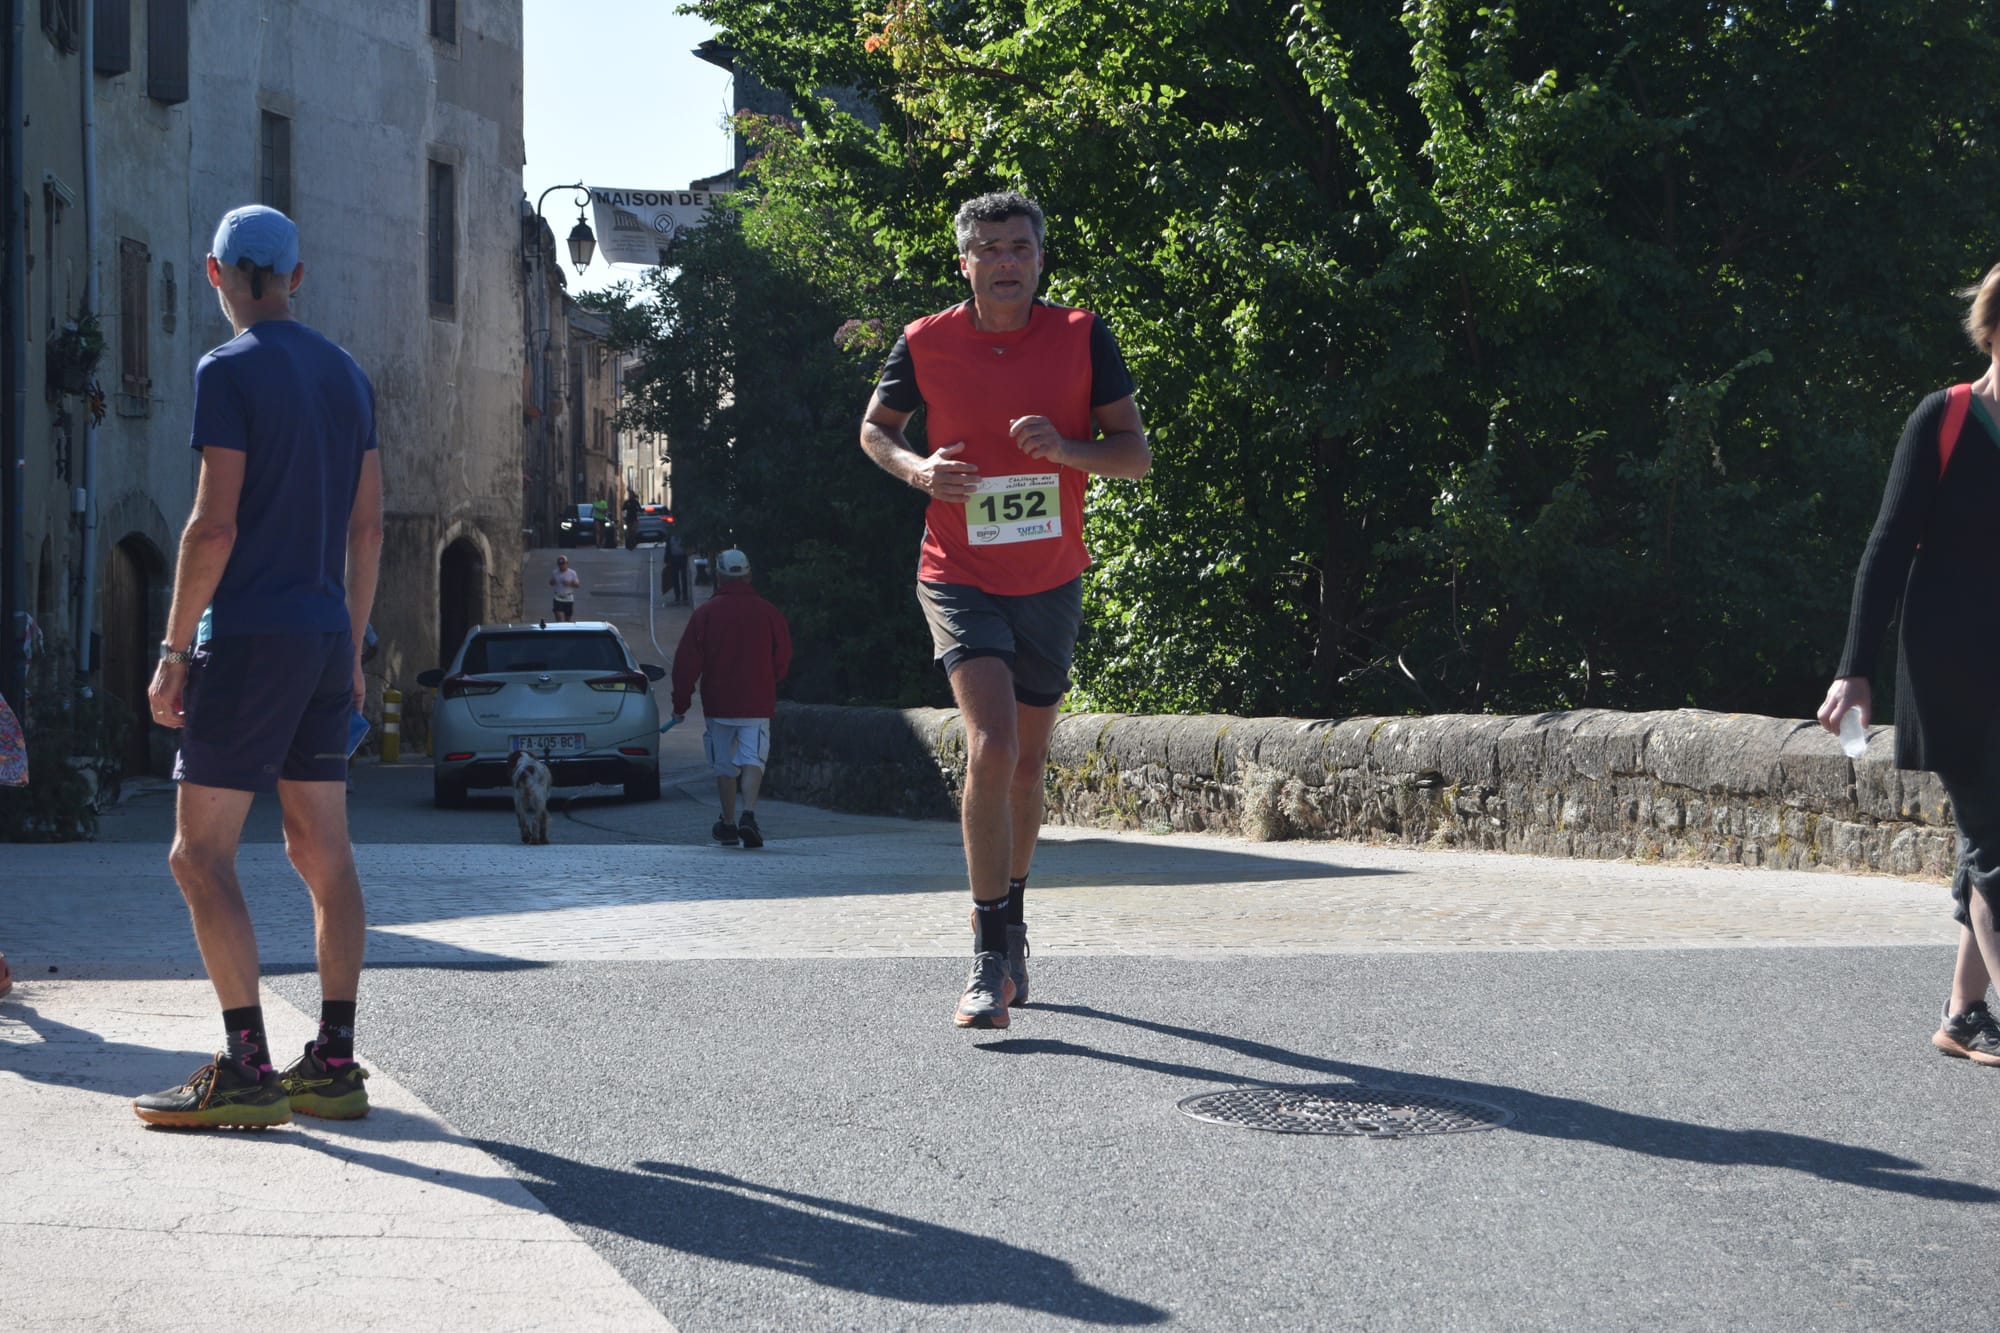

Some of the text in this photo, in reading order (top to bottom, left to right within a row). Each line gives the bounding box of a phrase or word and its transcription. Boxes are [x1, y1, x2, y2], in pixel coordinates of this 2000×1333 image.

[597, 191, 673, 206] MAISON
[679, 192, 704, 206] DE
[980, 491, 1047, 522] 152
